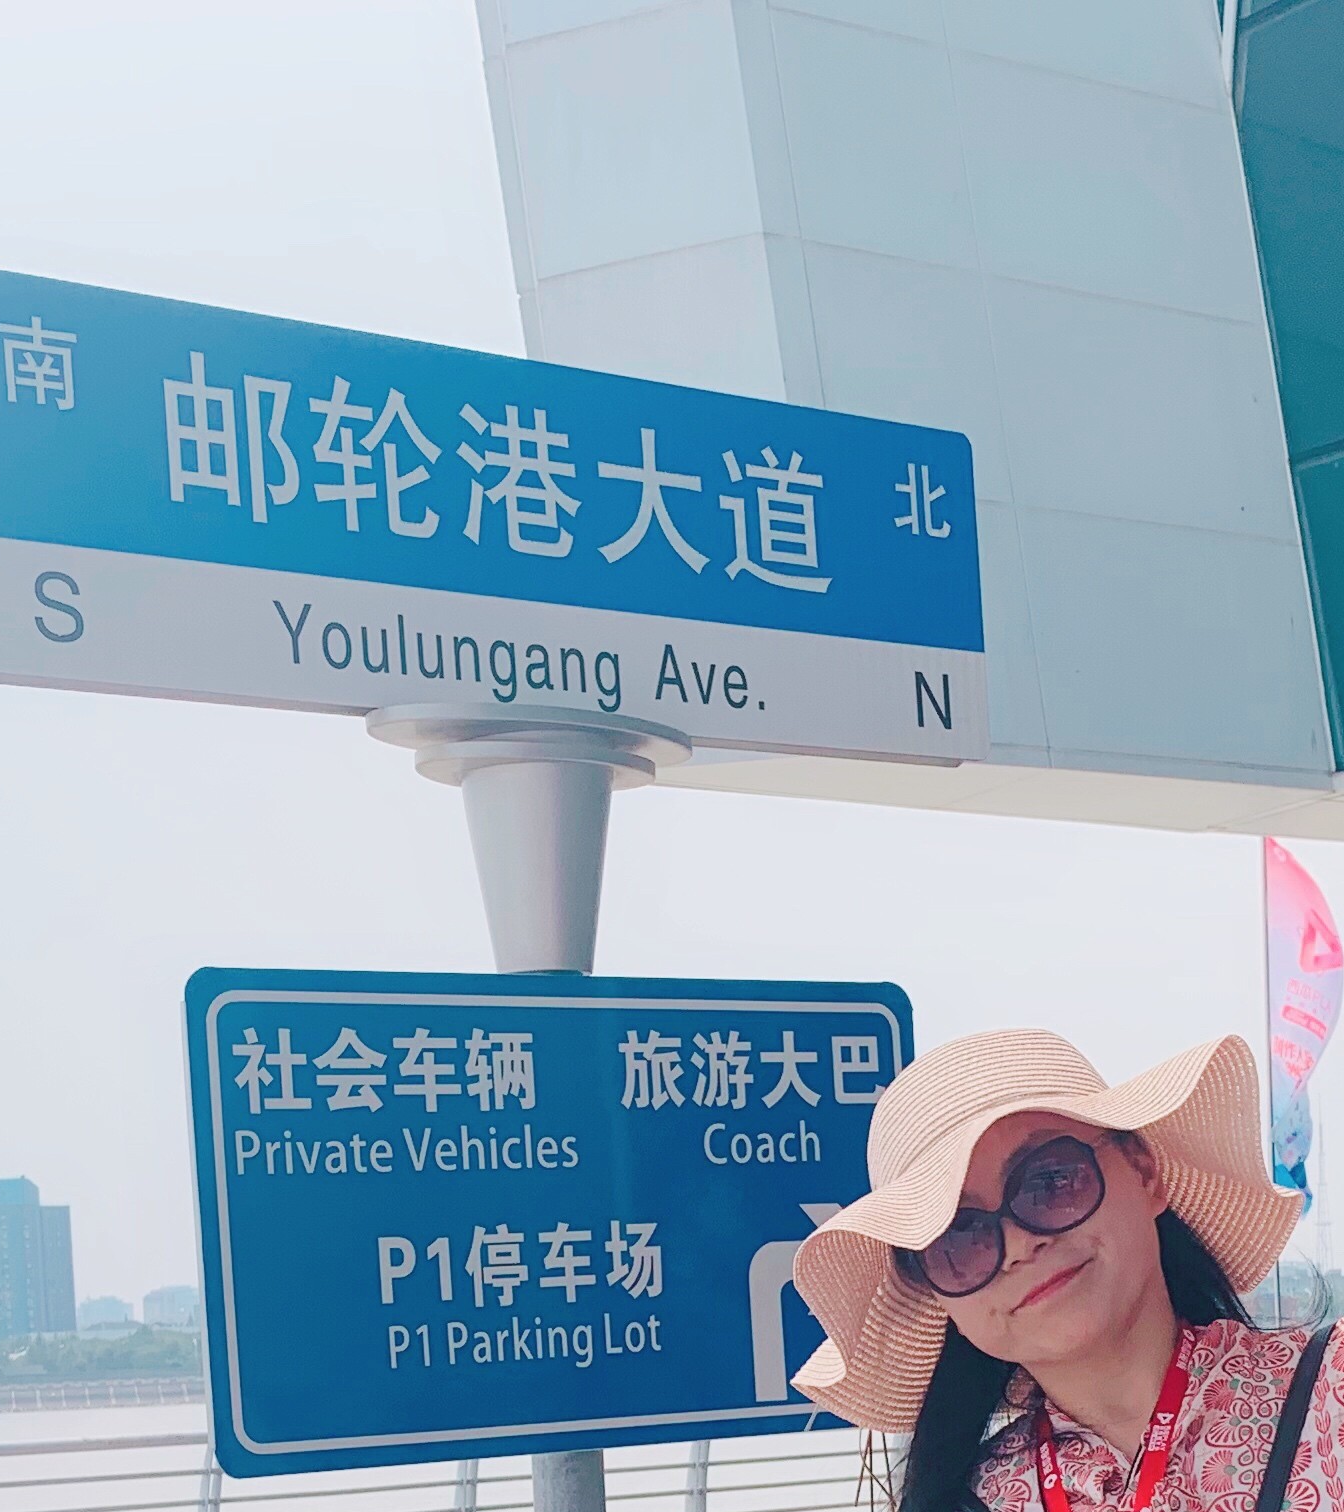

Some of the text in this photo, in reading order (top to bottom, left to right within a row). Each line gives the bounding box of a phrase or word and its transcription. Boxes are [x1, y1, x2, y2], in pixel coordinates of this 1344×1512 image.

[162, 350, 833, 594] 邮轮港大道
[893, 462, 951, 539] 北
[34, 571, 85, 643] S
[272, 600, 767, 713] Youlungang Ave.
[914, 670, 953, 730] N
[231, 1026, 536, 1115] 社会车辆
[618, 1029, 886, 1112] 旅游大巴
[234, 1123, 580, 1176] Private Vehicles
[703, 1119, 821, 1166] Coach
[377, 1220, 664, 1308] P1停车场
[388, 1312, 663, 1369] P1 Parking Lot
